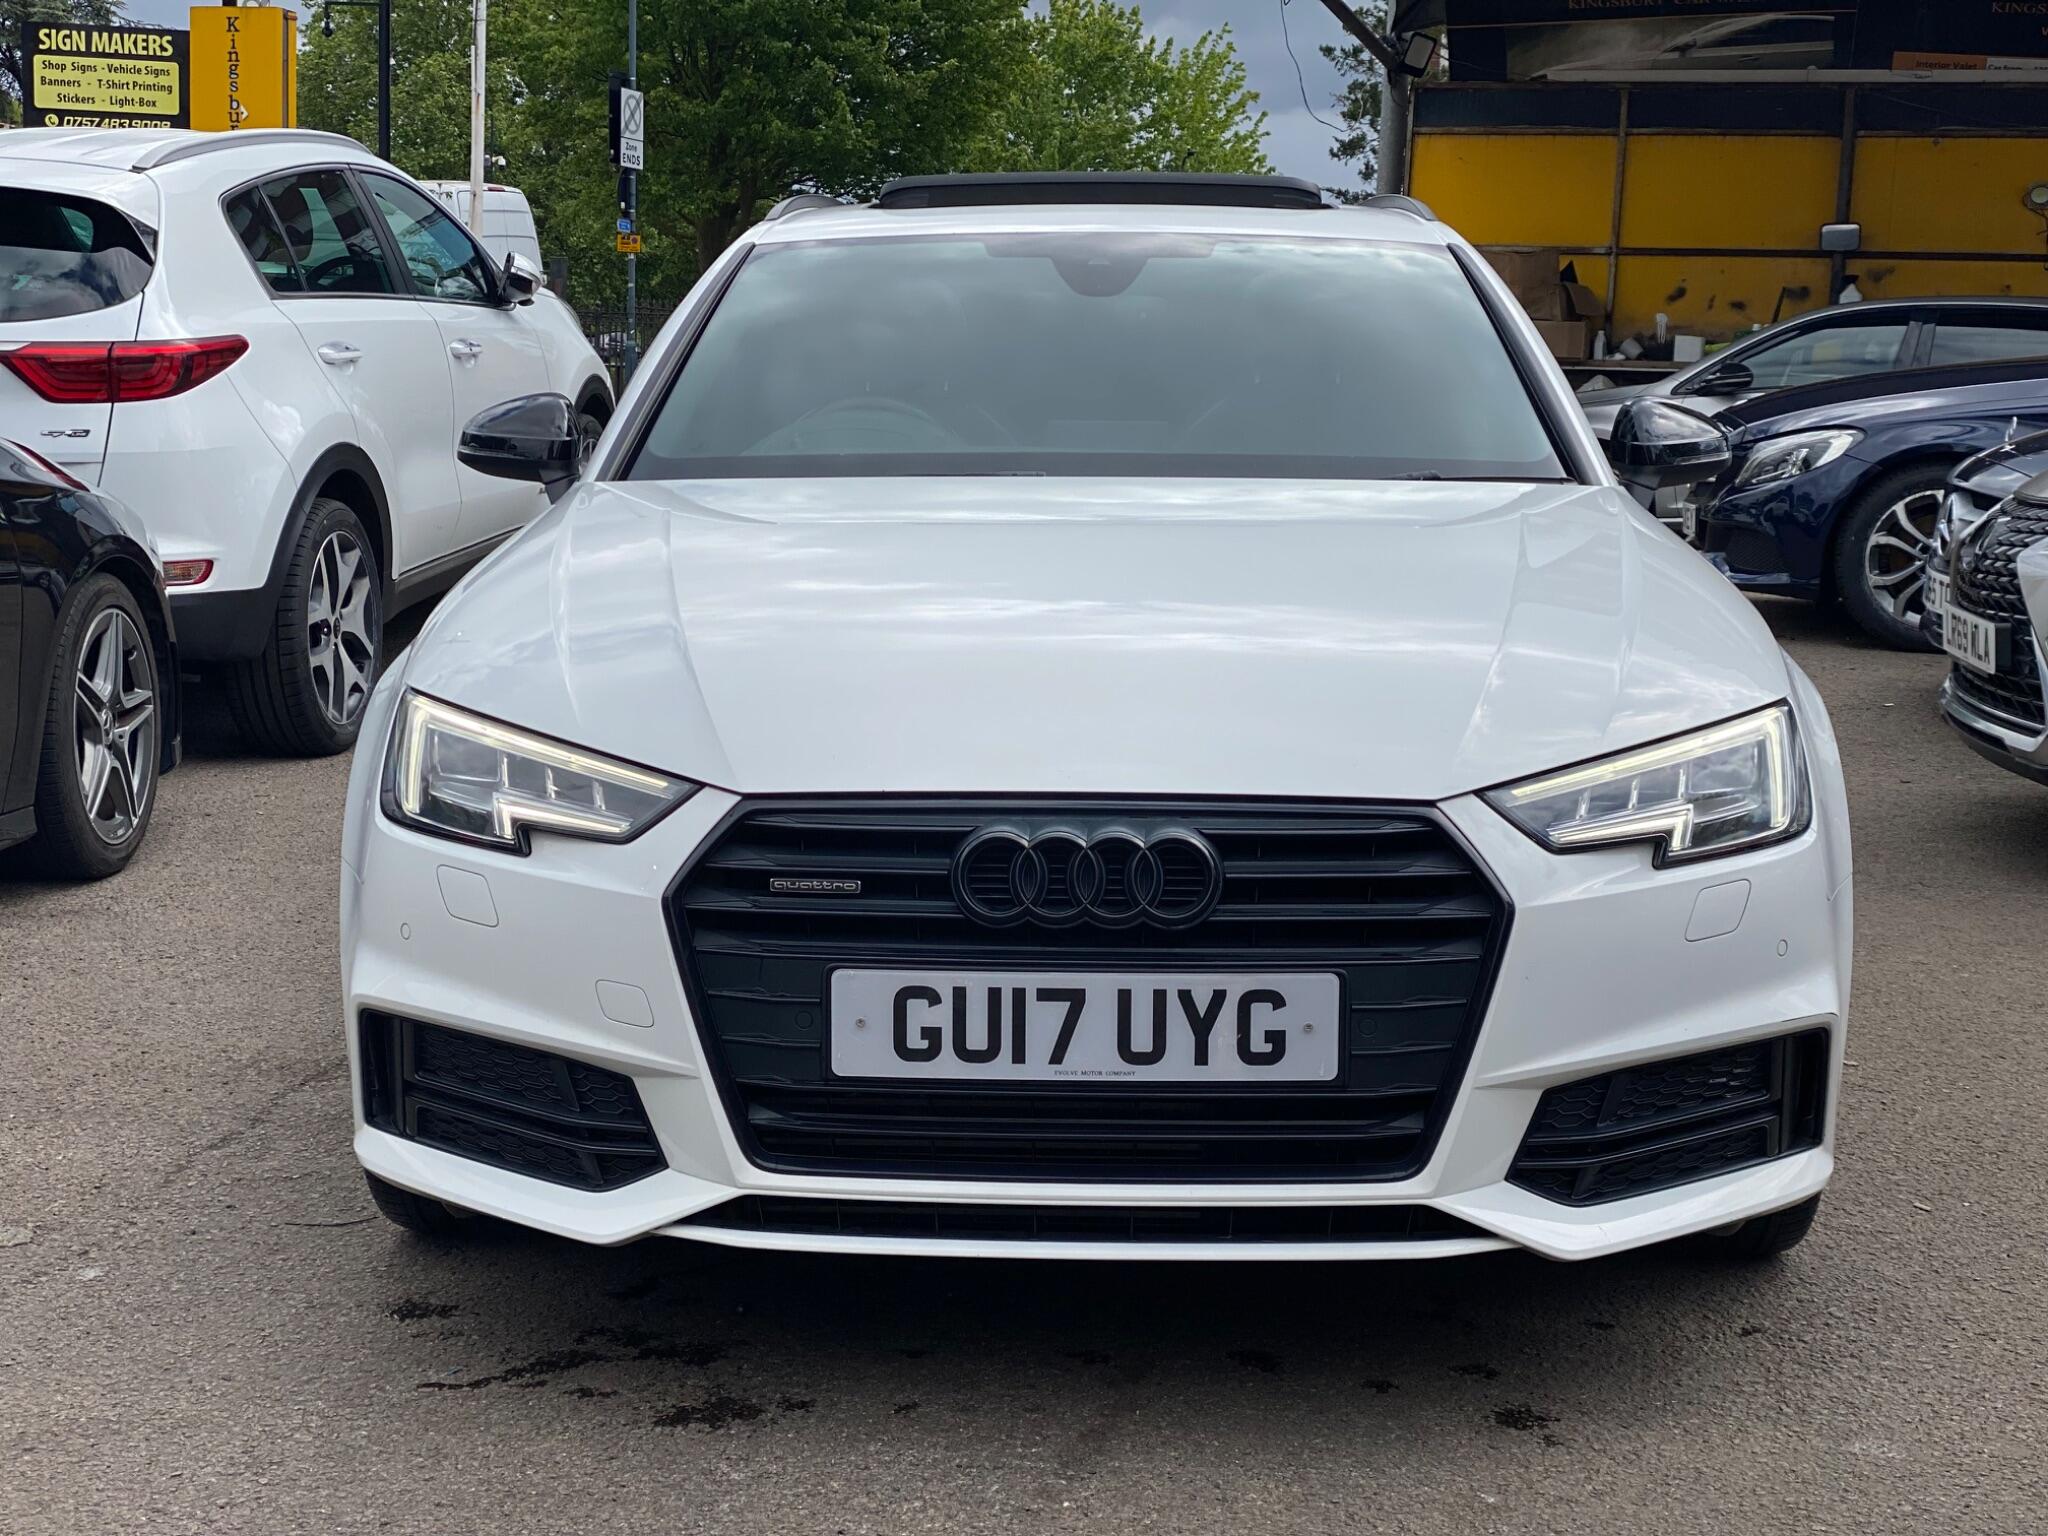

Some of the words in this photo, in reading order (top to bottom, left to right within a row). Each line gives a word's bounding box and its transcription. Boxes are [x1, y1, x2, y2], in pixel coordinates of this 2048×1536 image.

[1992, 2, 2048, 12] KINGS
[38, 28, 86, 51] SIGN
[91, 31, 174, 57] MAKERS
[42, 60, 67, 72] Shop
[71, 61, 98, 74] Signs
[107, 63, 142, 75] Vehicle
[144, 66, 171, 78] Signs
[1916, 60, 1952, 69] Interior
[40, 76, 81, 88] Banners
[96, 78, 130, 90] T-Shirt
[132, 82, 173, 95] Printing
[57, 92, 96, 104] Stickers
[109, 95, 157, 108] Light-Box
[625, 141, 638, 152] Zone
[622, 152, 641, 166] ENDS
[774, 881, 857, 890] quattro
[892, 985, 1086, 1065] GU17
[1117, 987, 1287, 1066] UYG
